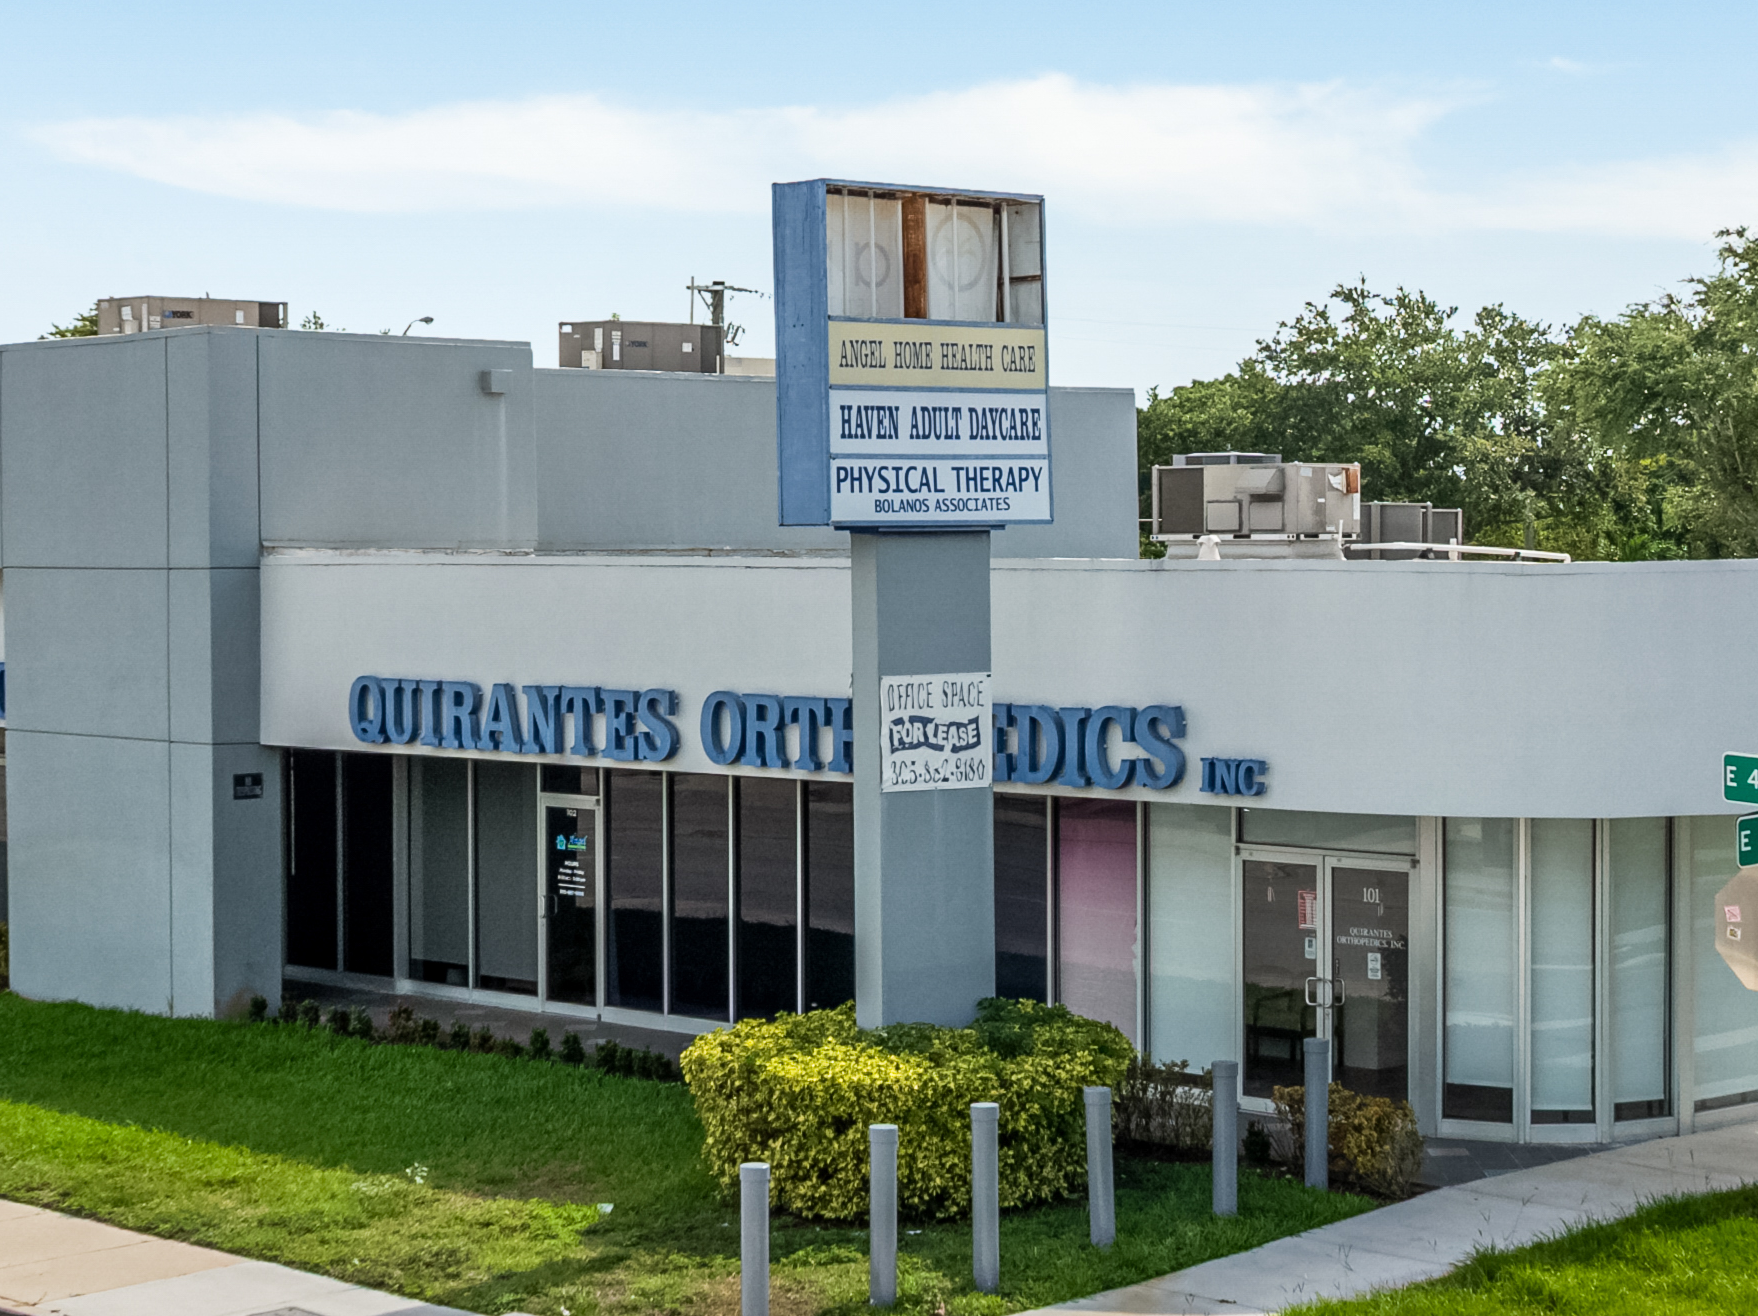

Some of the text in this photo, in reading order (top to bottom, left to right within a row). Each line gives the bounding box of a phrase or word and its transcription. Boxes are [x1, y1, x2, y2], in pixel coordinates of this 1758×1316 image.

[839, 339, 1036, 373] ANGEL HOME HEALTH CARE
[839, 405, 1042, 441] HAVEN ADULT DAYCARE
[836, 466, 1043, 494] PHYSICAL THERAPY
[874, 497, 1011, 513] BOLANOS ASSOCIATES
[887, 681, 984, 712] OFFICE SPACE
[348, 675, 679, 762] QUIRANTES
[1200, 757, 1267, 796] INC
[889, 721, 978, 747] FOR LEASE
[1726, 765, 1738, 787] E
[1741, 830, 1752, 852] E
[1363, 887, 1381, 903] 101
[1349, 927, 1393, 938] QUIRANTES
